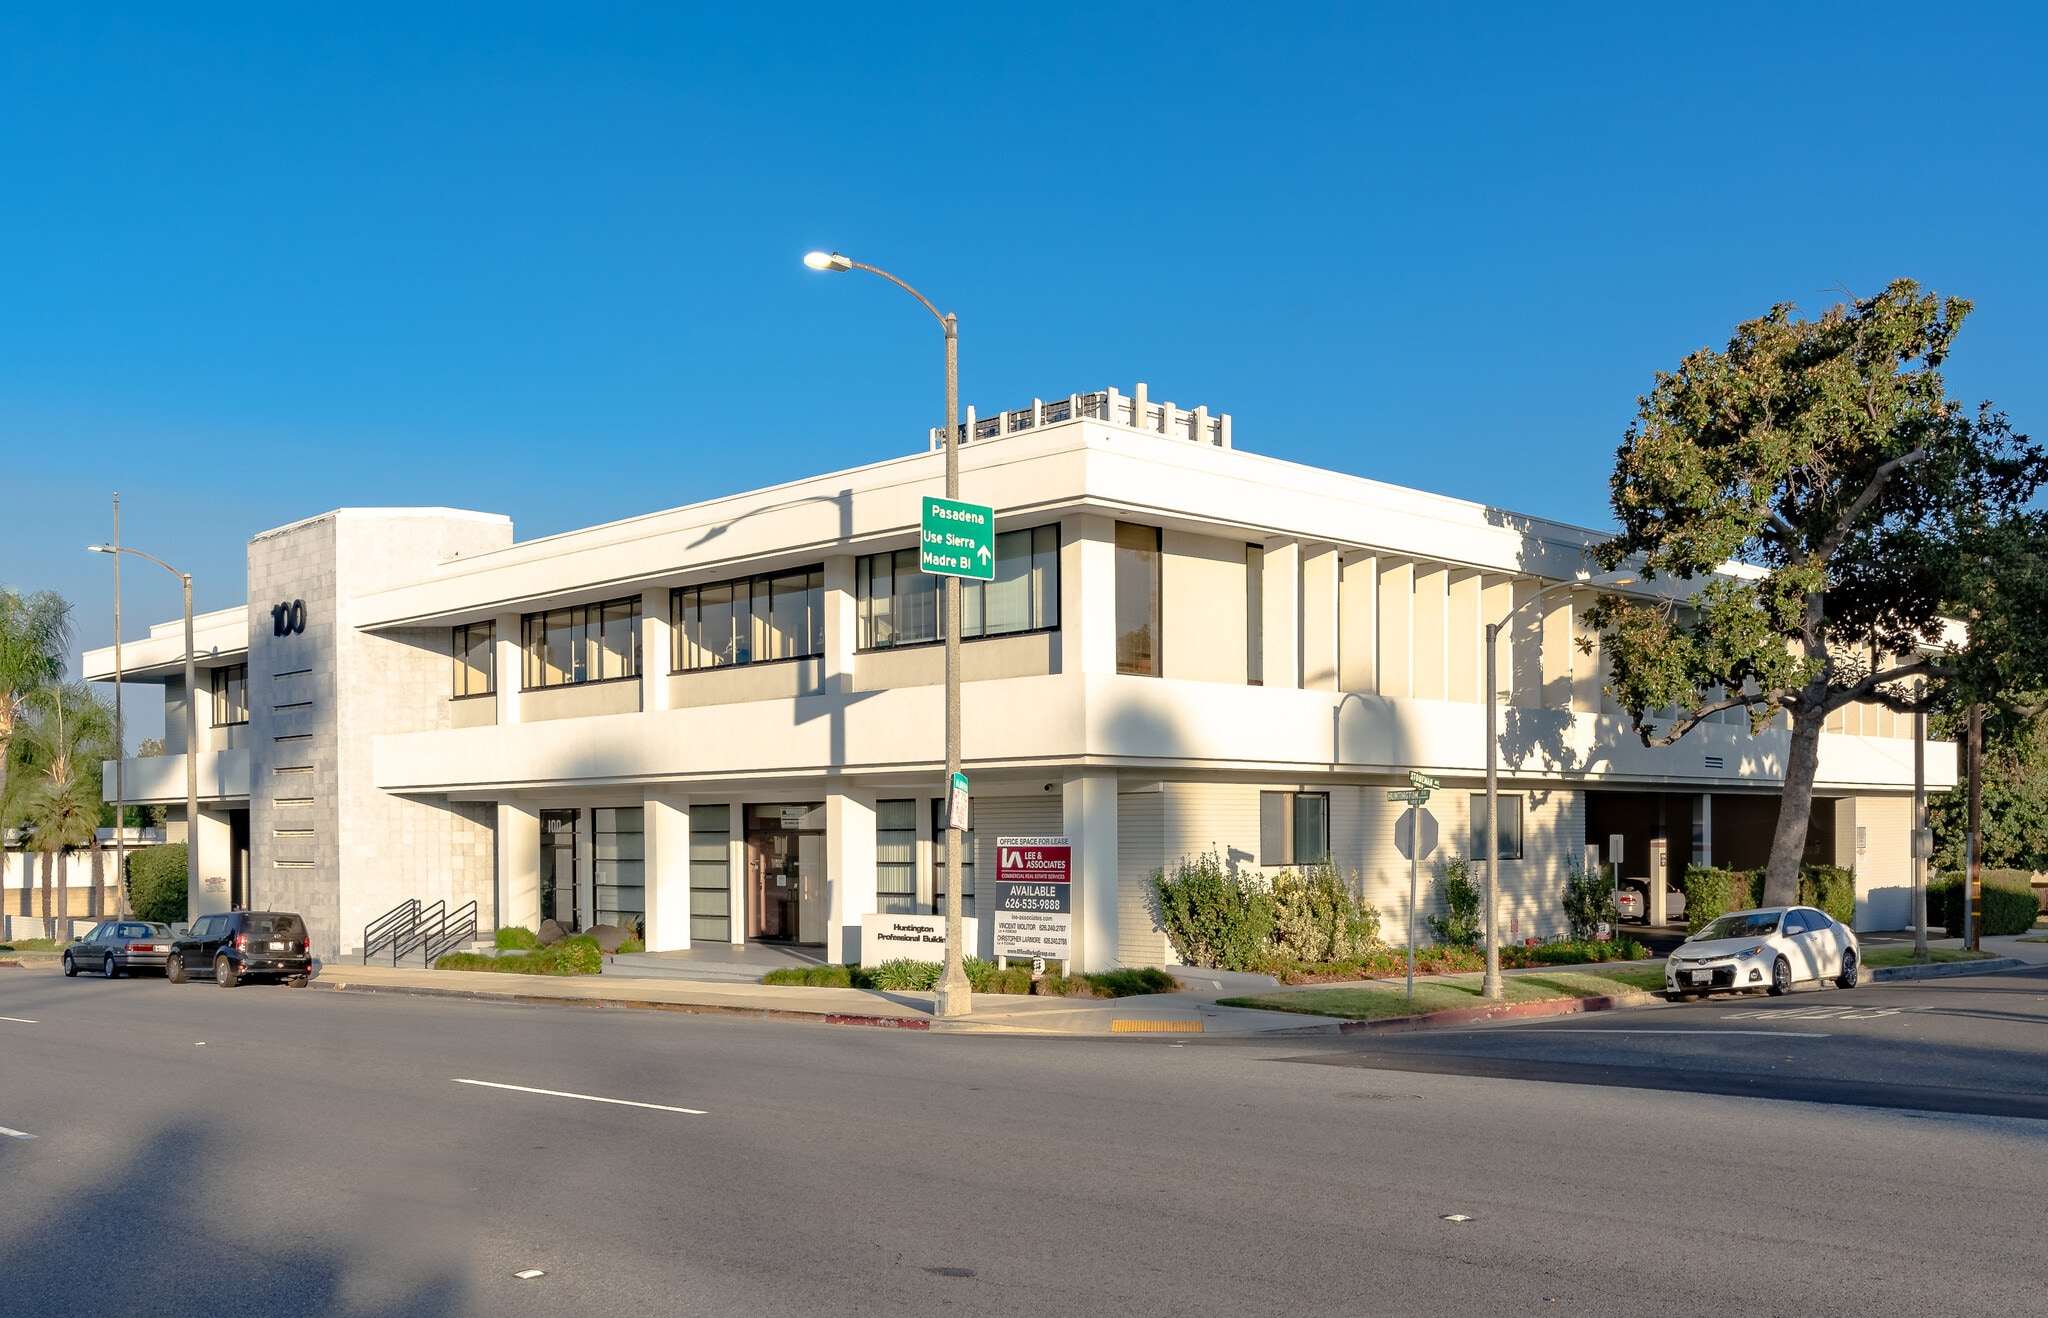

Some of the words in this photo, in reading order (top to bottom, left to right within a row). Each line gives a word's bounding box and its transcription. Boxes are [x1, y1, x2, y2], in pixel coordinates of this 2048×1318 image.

[932, 504, 984, 524] Pasadena
[923, 530, 943, 544] Use
[945, 533, 975, 548] Sierra
[923, 551, 957, 567] Madre
[960, 556, 971, 569] Bl
[270, 599, 307, 637] 100
[548, 819, 561, 833] 100
[1024, 851, 1036, 860] LEE
[1036, 851, 1042, 860] &
[1026, 860, 1066, 869] ASSOCIATES
[1010, 885, 1056, 897] AVAILABLE
[1005, 898, 1060, 910] 626-535-9888
[1011, 914, 1053, 922] lee-associates.com
[893, 923, 934, 933] Huntington
[877, 933, 920, 942] Professional
[923, 935, 946, 943] Buildin
[997, 934, 1022, 943] CHRISTOPHER
